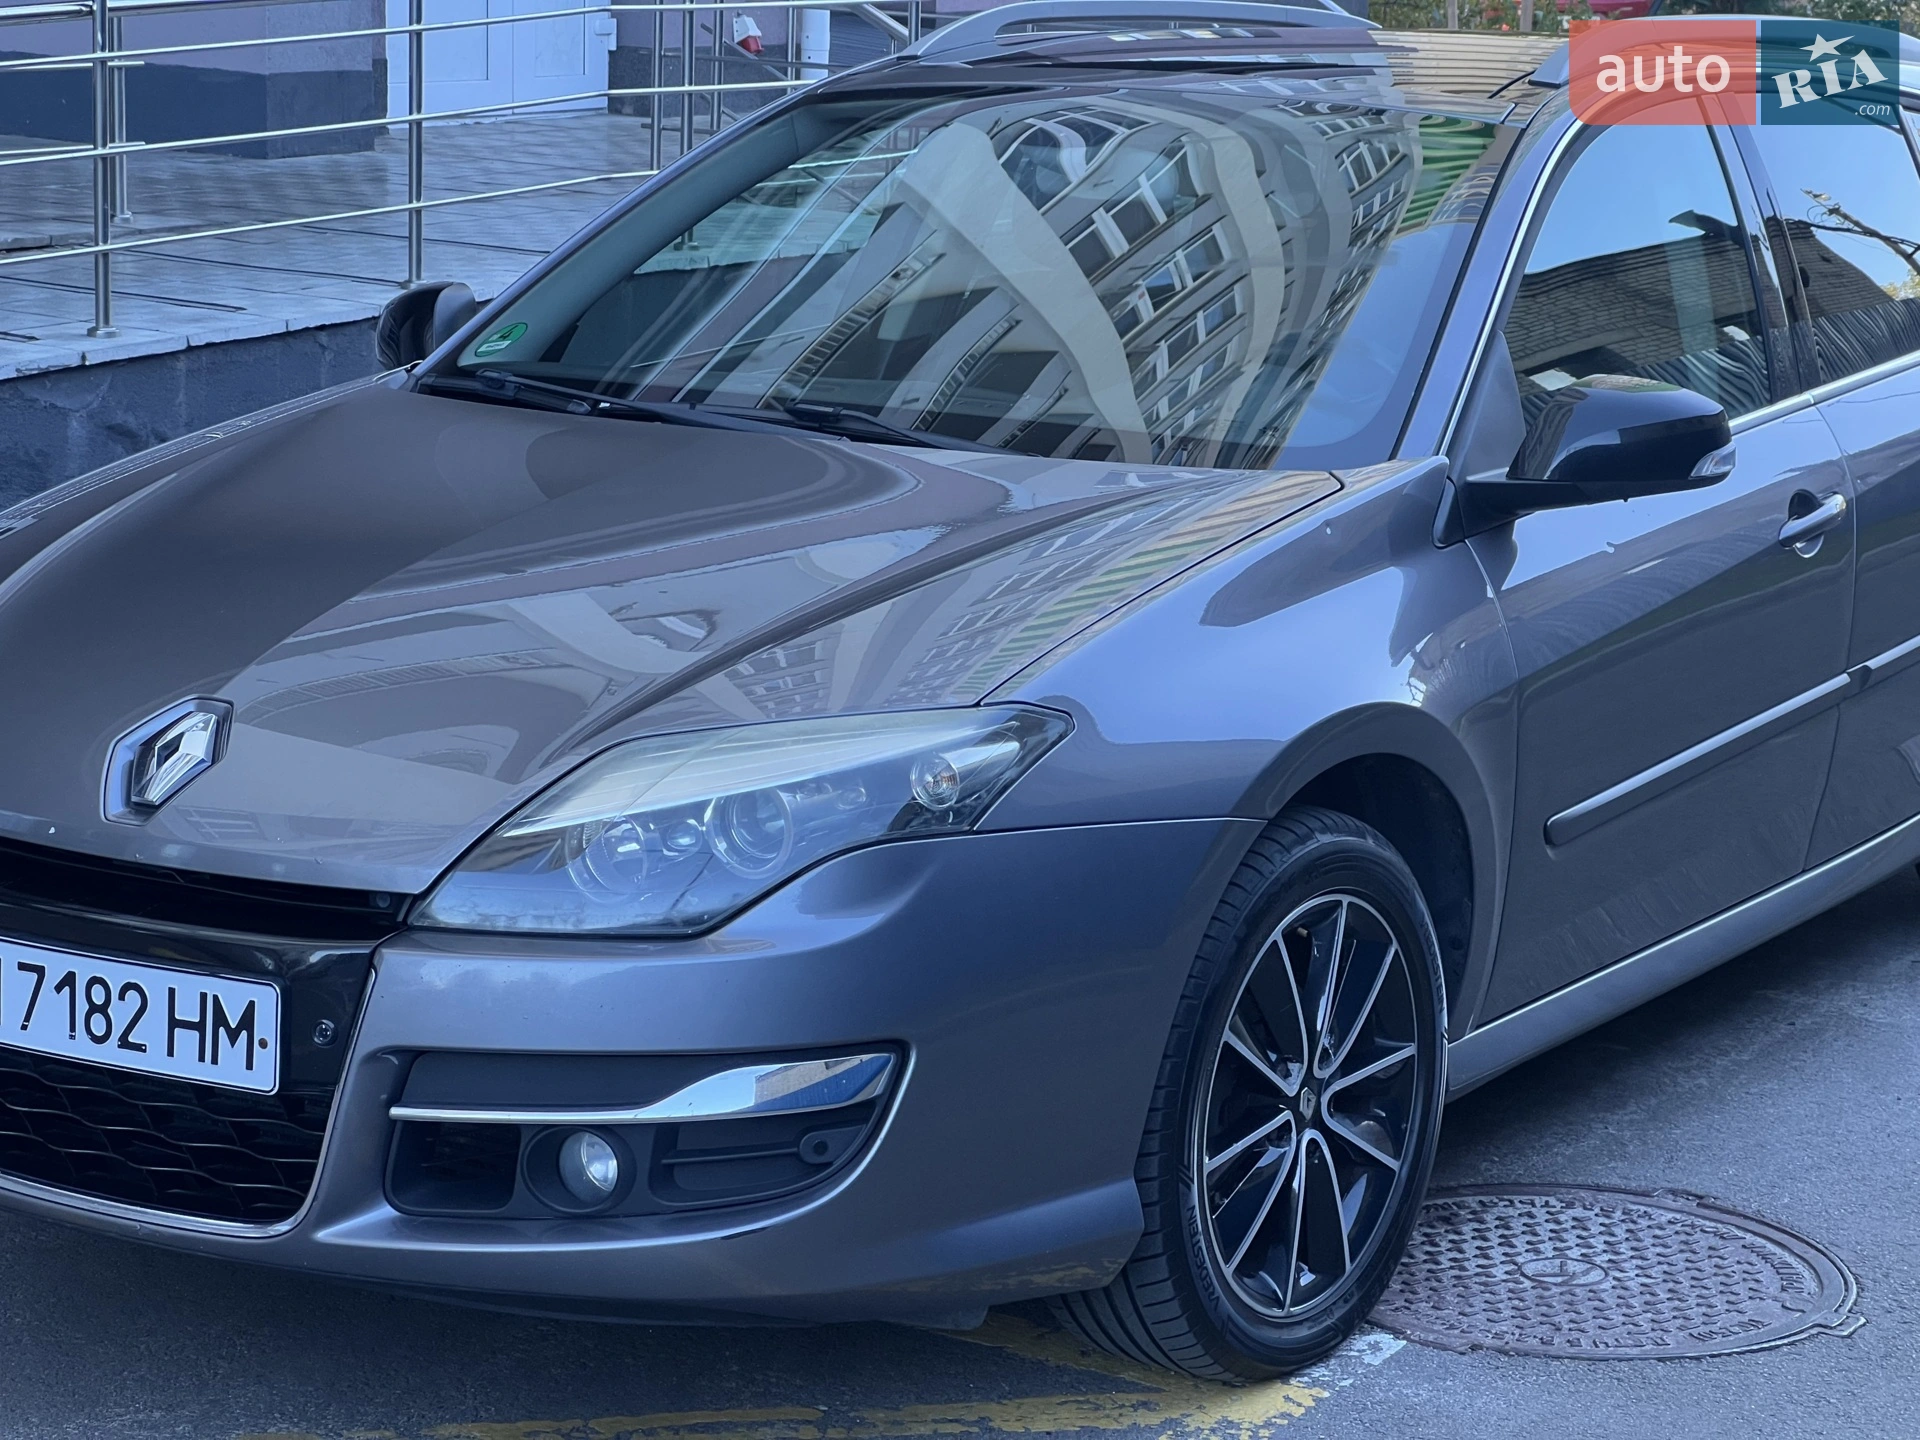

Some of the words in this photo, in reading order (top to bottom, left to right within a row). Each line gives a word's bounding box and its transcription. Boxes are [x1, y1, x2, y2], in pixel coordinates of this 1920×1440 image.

[17, 960, 149, 1054] 7182
[166, 986, 256, 1071] HM
[1185, 1204, 1221, 1312] VREDESTEIN
